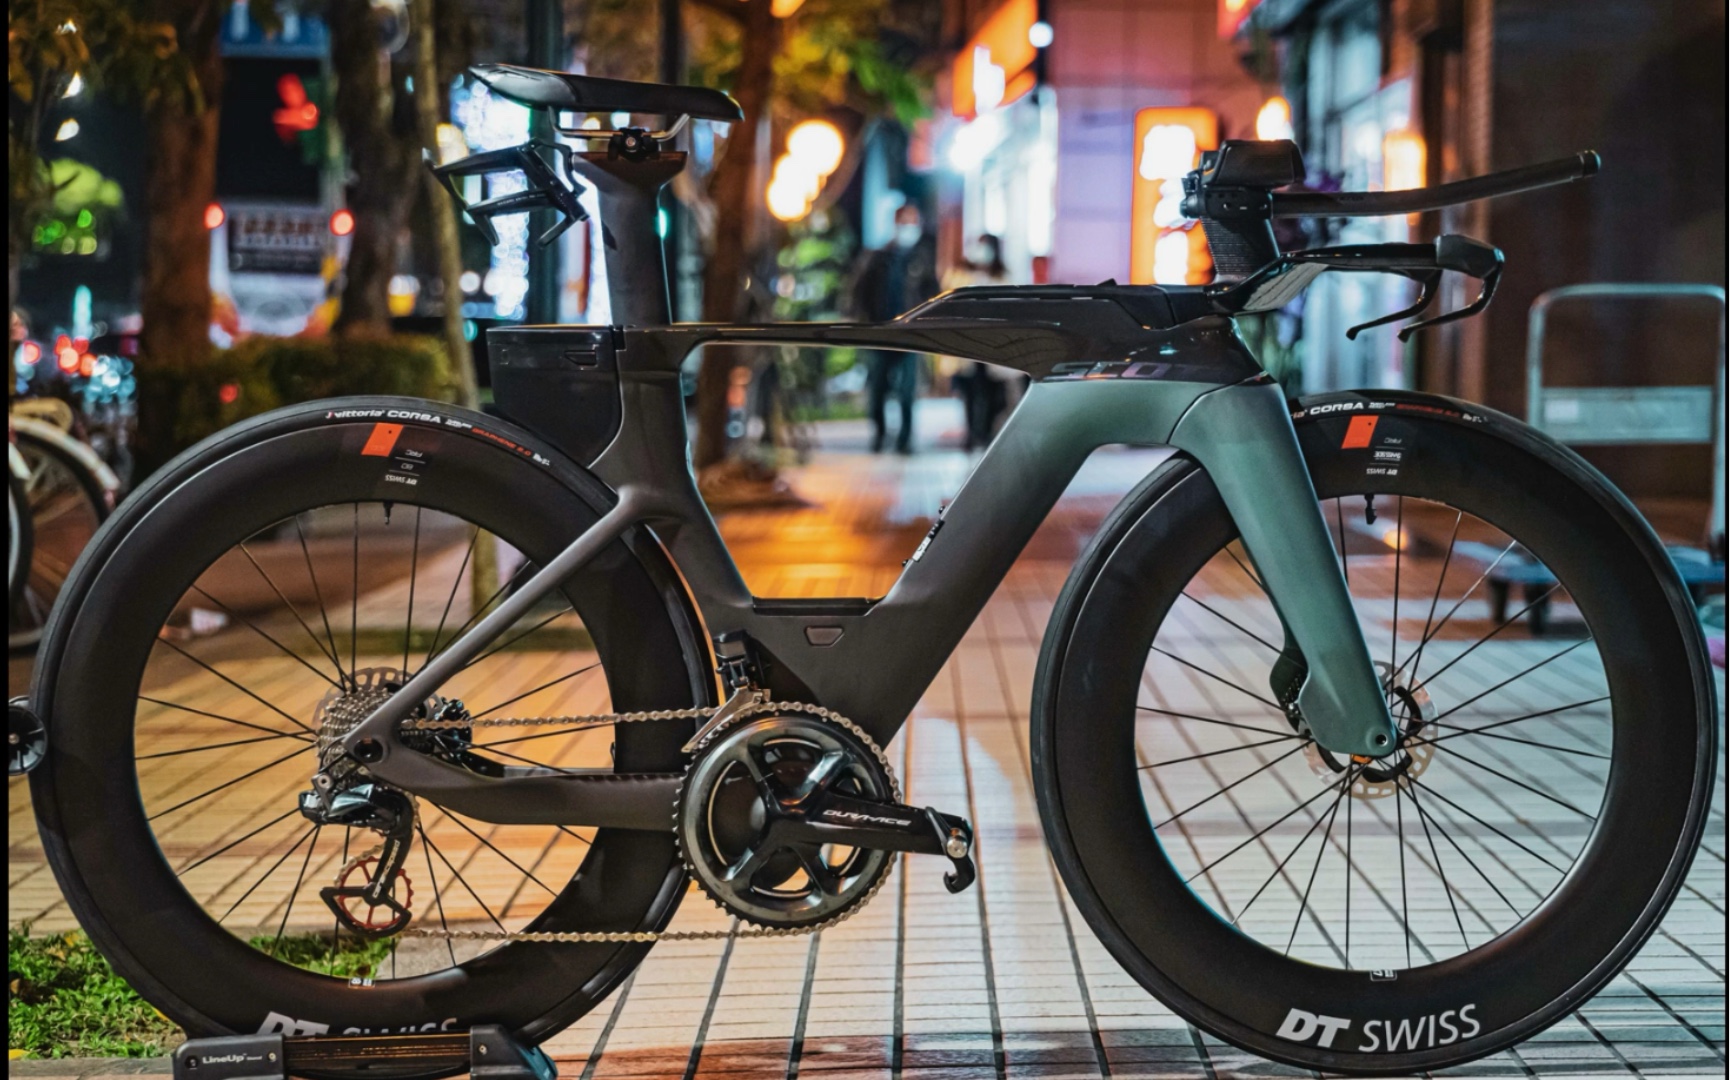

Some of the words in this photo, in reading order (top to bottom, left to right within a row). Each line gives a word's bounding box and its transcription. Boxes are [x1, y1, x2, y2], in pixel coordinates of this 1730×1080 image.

[1310, 402, 1364, 415] CORSA
[334, 409, 382, 419] vittoria
[387, 409, 441, 423] CORSA
[1275, 1007, 1352, 1049] DT
[1358, 1003, 1481, 1053] SWISS
[202, 1054, 245, 1064] LineUp
